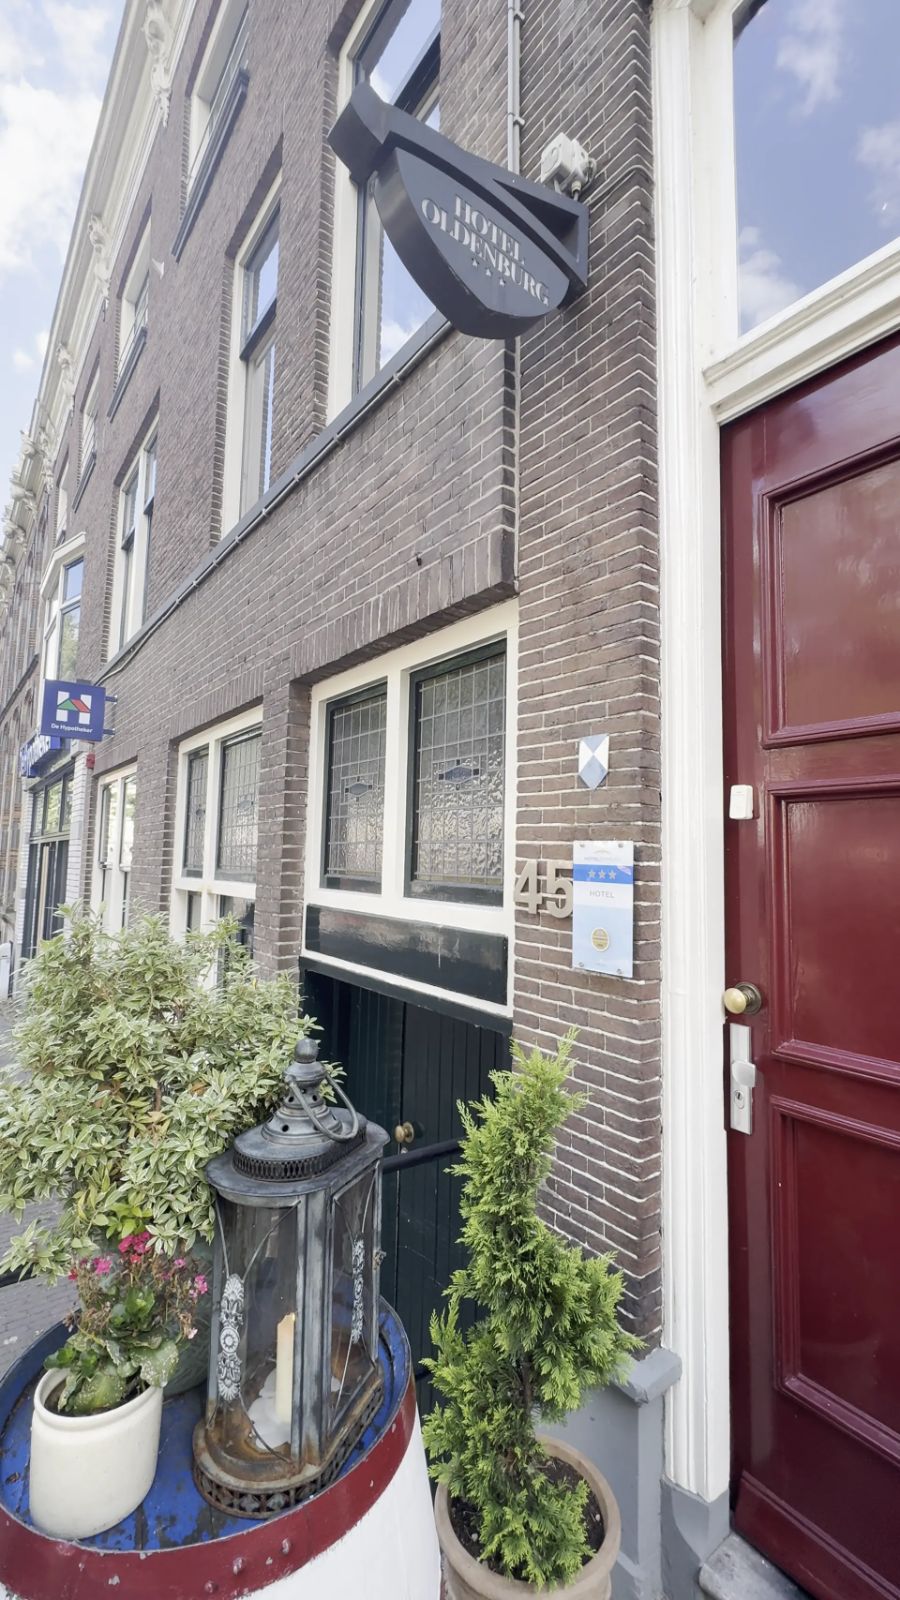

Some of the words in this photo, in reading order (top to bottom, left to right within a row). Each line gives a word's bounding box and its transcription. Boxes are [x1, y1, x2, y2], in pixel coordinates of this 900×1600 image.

[421, 198, 549, 306] OLDENBURG
[455, 196, 525, 265] HOTEL
[61, 724, 93, 733] Hypotheker
[513, 859, 573, 919] 45
[589, 890, 615, 899] HOTEL
